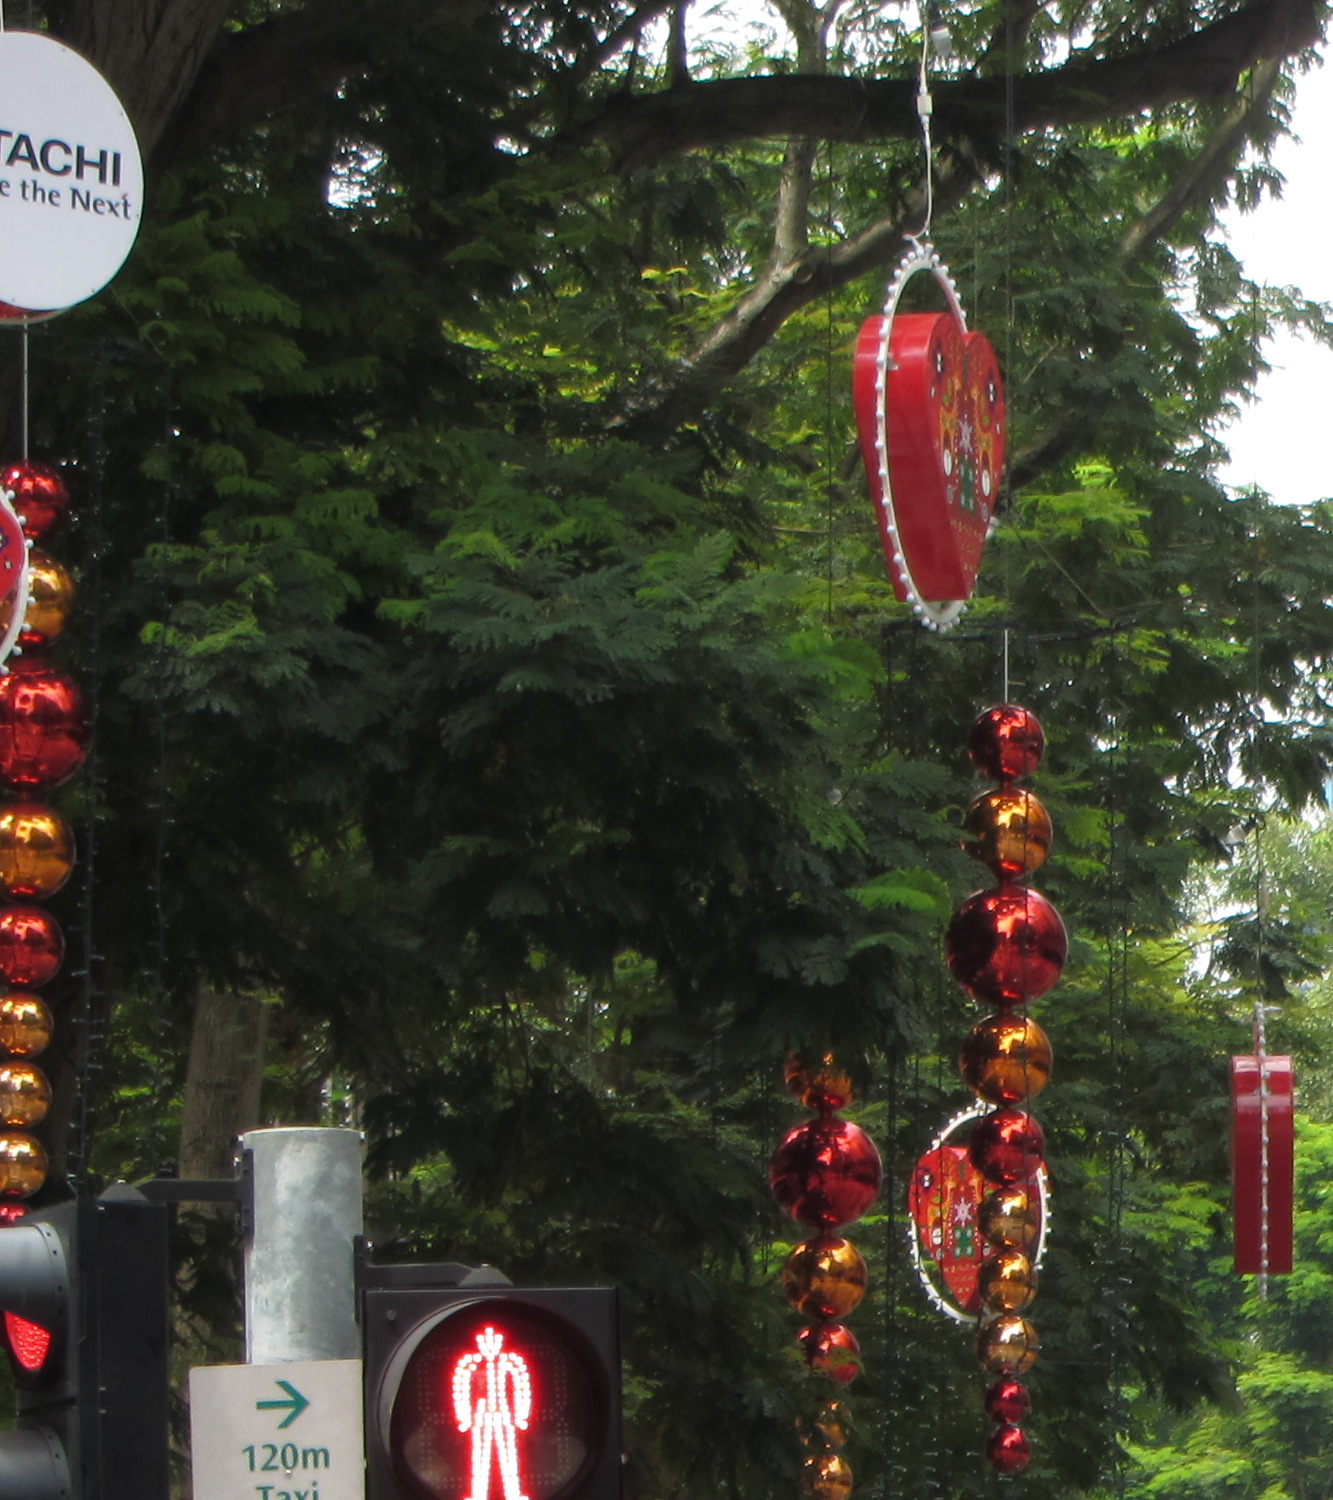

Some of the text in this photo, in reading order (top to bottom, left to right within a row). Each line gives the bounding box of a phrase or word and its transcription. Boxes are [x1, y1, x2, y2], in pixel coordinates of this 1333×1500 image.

[20, 179, 61, 207] the
[70, 186, 131, 220] Next
[242, 1442, 331, 1472] 120m
